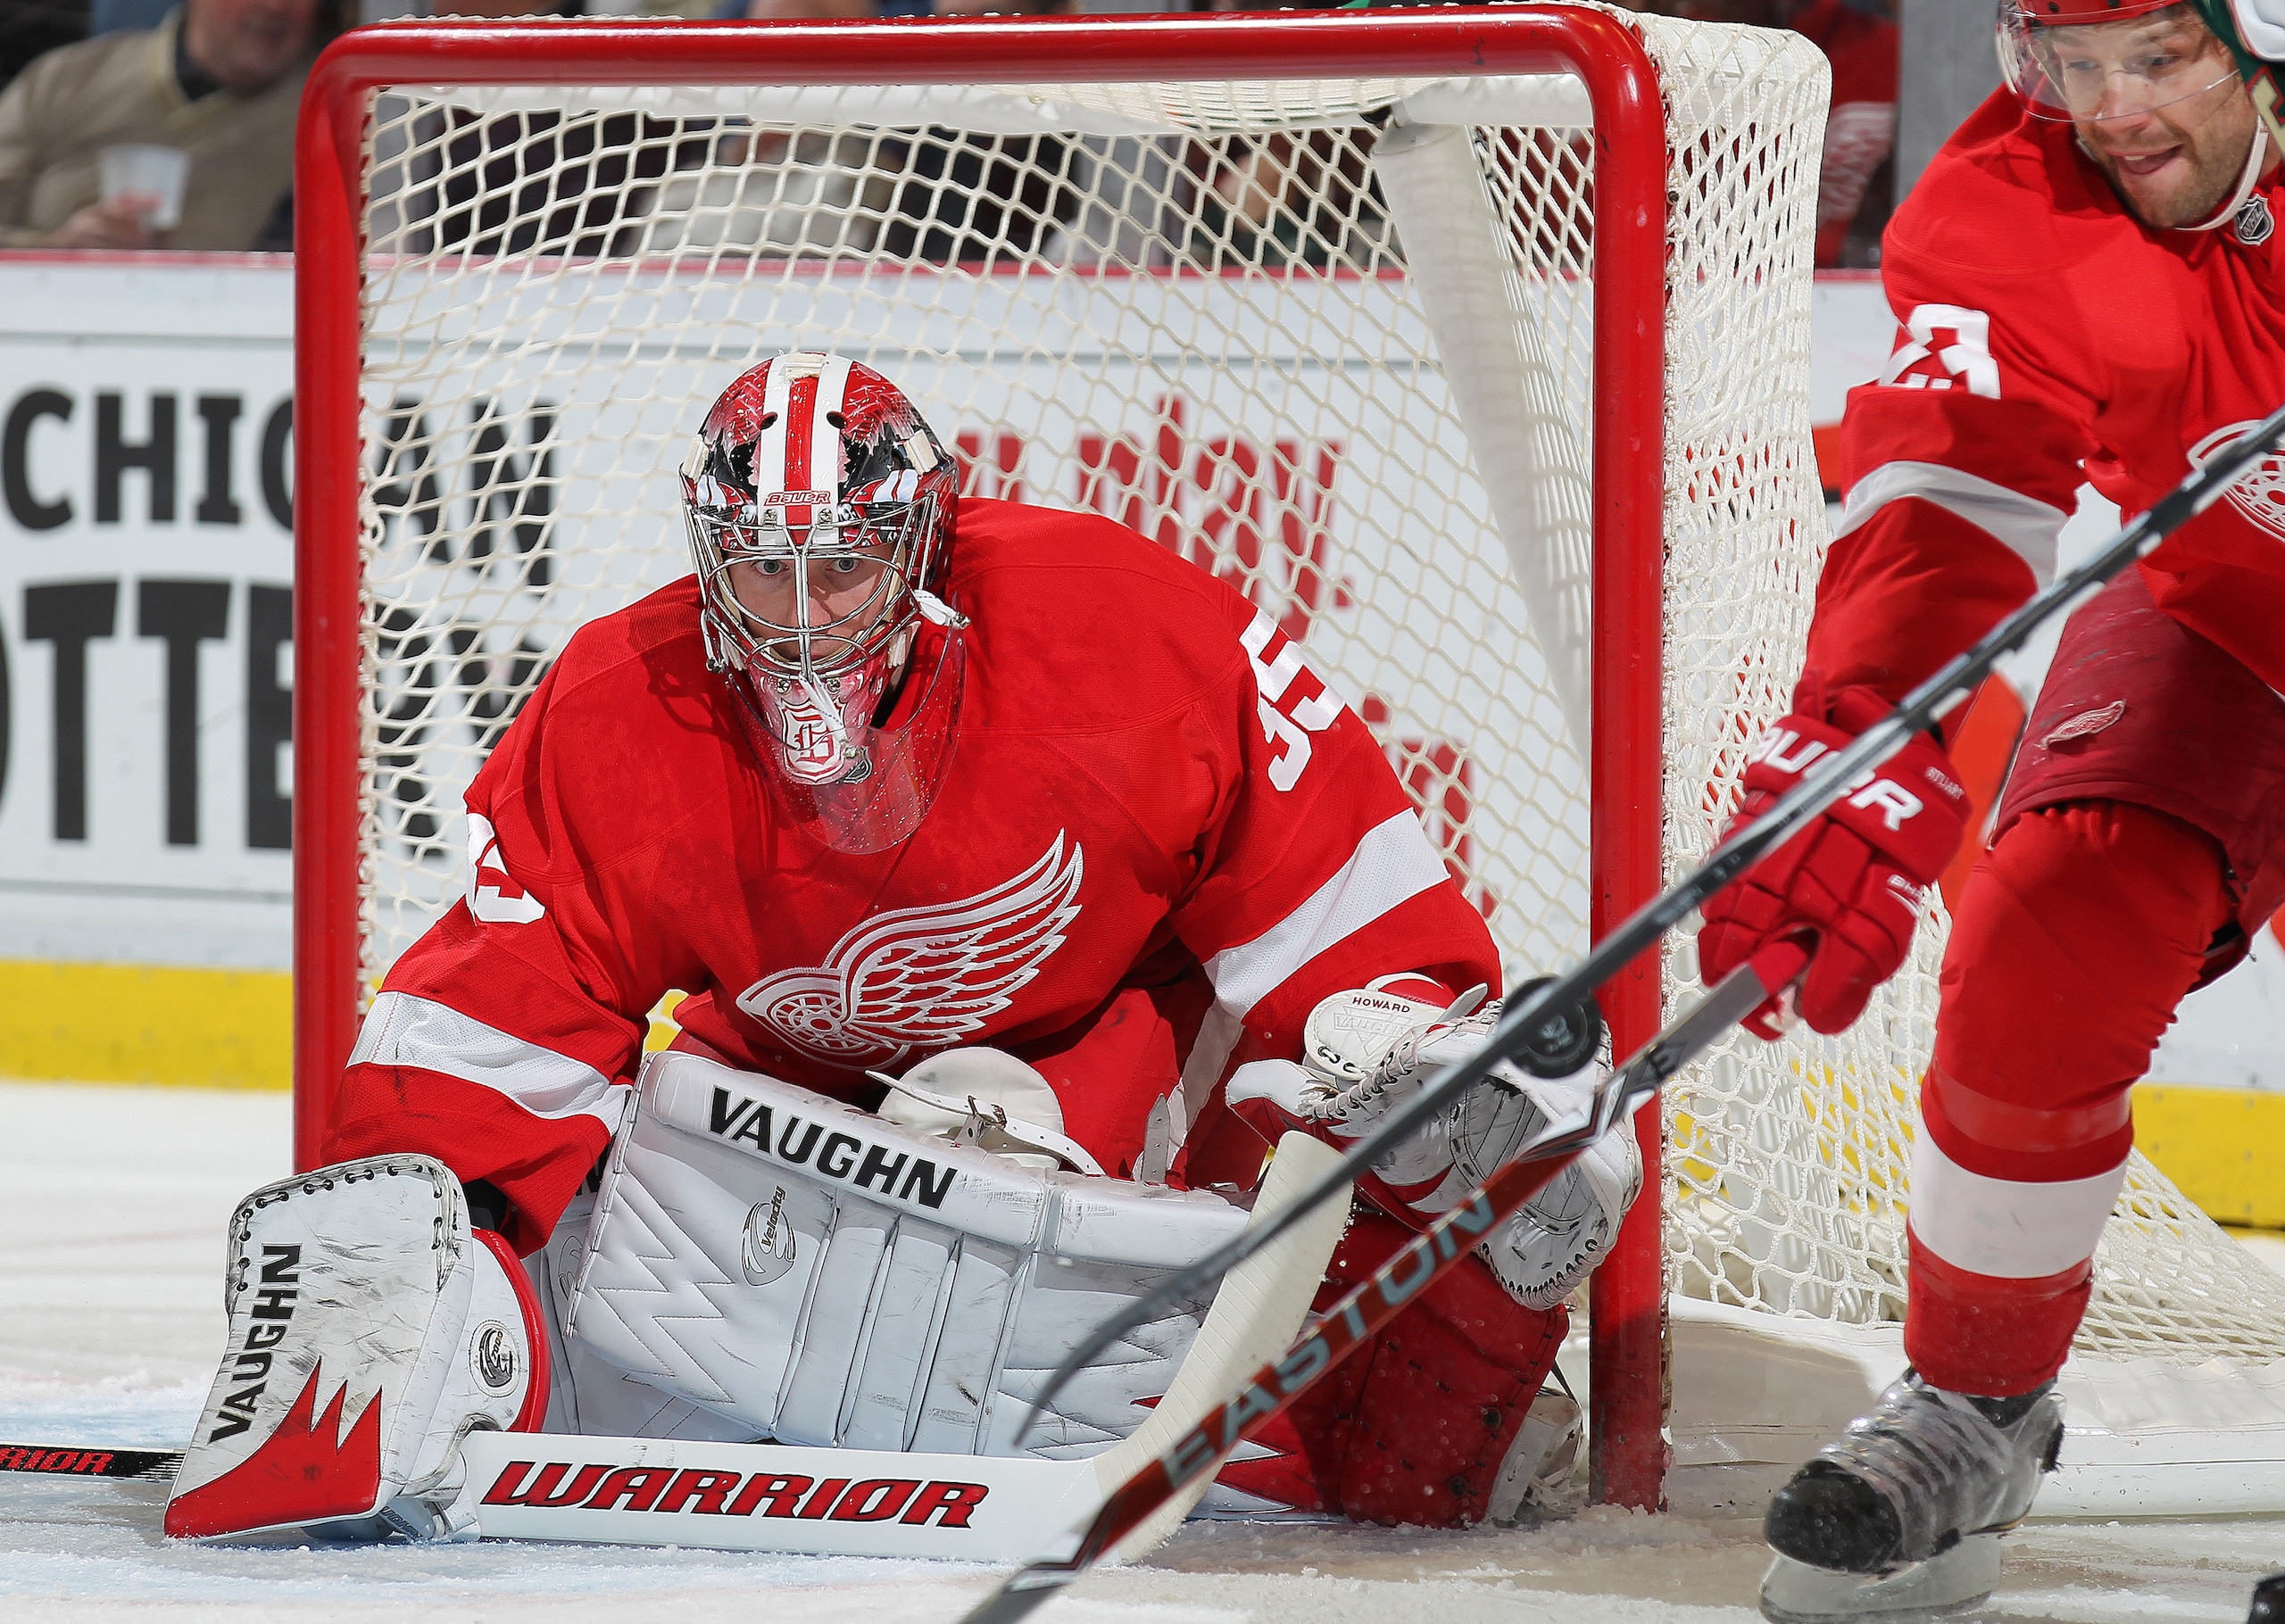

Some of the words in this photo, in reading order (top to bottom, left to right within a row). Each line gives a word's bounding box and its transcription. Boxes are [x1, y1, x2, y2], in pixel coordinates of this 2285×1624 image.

[1352, 996, 1411, 1014] HOWARD
[710, 1085, 960, 1212] VAUGHN
[761, 1185, 786, 1247] Velocity
[207, 1242, 303, 1446] VAUGHN
[1159, 1185, 1497, 1490] EASTON
[479, 1460, 990, 1529] WARRIOR
